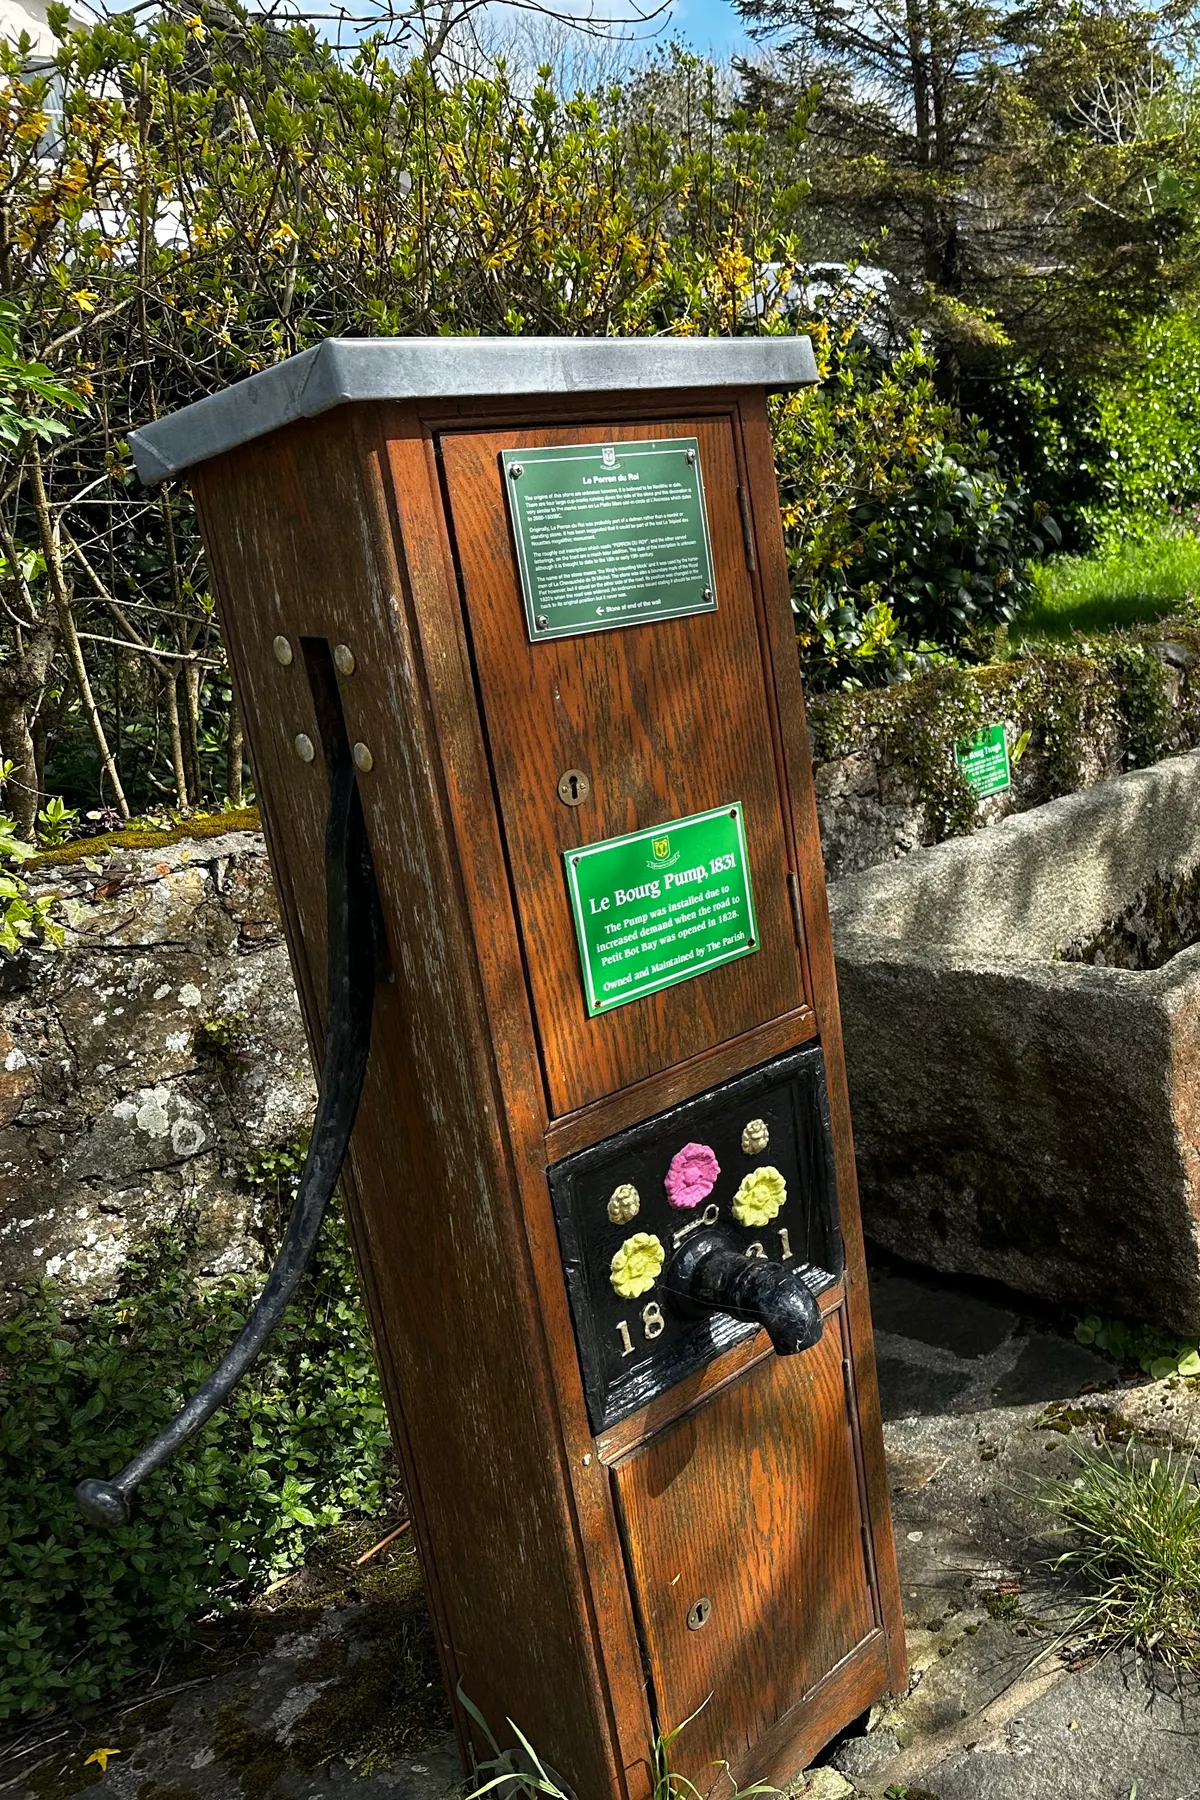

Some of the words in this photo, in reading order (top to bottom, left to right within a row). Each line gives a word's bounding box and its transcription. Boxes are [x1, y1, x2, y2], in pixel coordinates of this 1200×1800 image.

[589, 897, 610, 914] Le
[614, 880, 661, 906] Bourg
[663, 865, 708, 889] Pump,
[709, 852, 736, 874] 1831
[604, 923, 621, 934] The
[623, 914, 648, 928] Pump
[649, 907, 666, 918] was
[668, 892, 703, 912] installed
[704, 888, 720, 899] due
[721, 885, 729, 893] to
[596, 930, 638, 952] increased
[640, 918, 673, 937] demand
[674, 911, 696, 924] when
[698, 906, 711, 916] the
[712, 897, 730, 911] road
[731, 896, 740, 904] to
[601, 952, 622, 966] Petit
[624, 946, 639, 958] Bot
[641, 940, 657, 951] Bay
[659, 933, 676, 944] was
[677, 920, 706, 939] opened
[708, 919, 716, 927] in
[718, 910, 739, 923] 1828.
[603, 973, 632, 991] Owned
[634, 966, 649, 980] and
[651, 949, 694, 973] Maintained
[695, 947, 705, 957] by
[706, 941, 721, 952] The
[722, 931, 745, 946] Parish
[616, 1302, 664, 1358] 18
